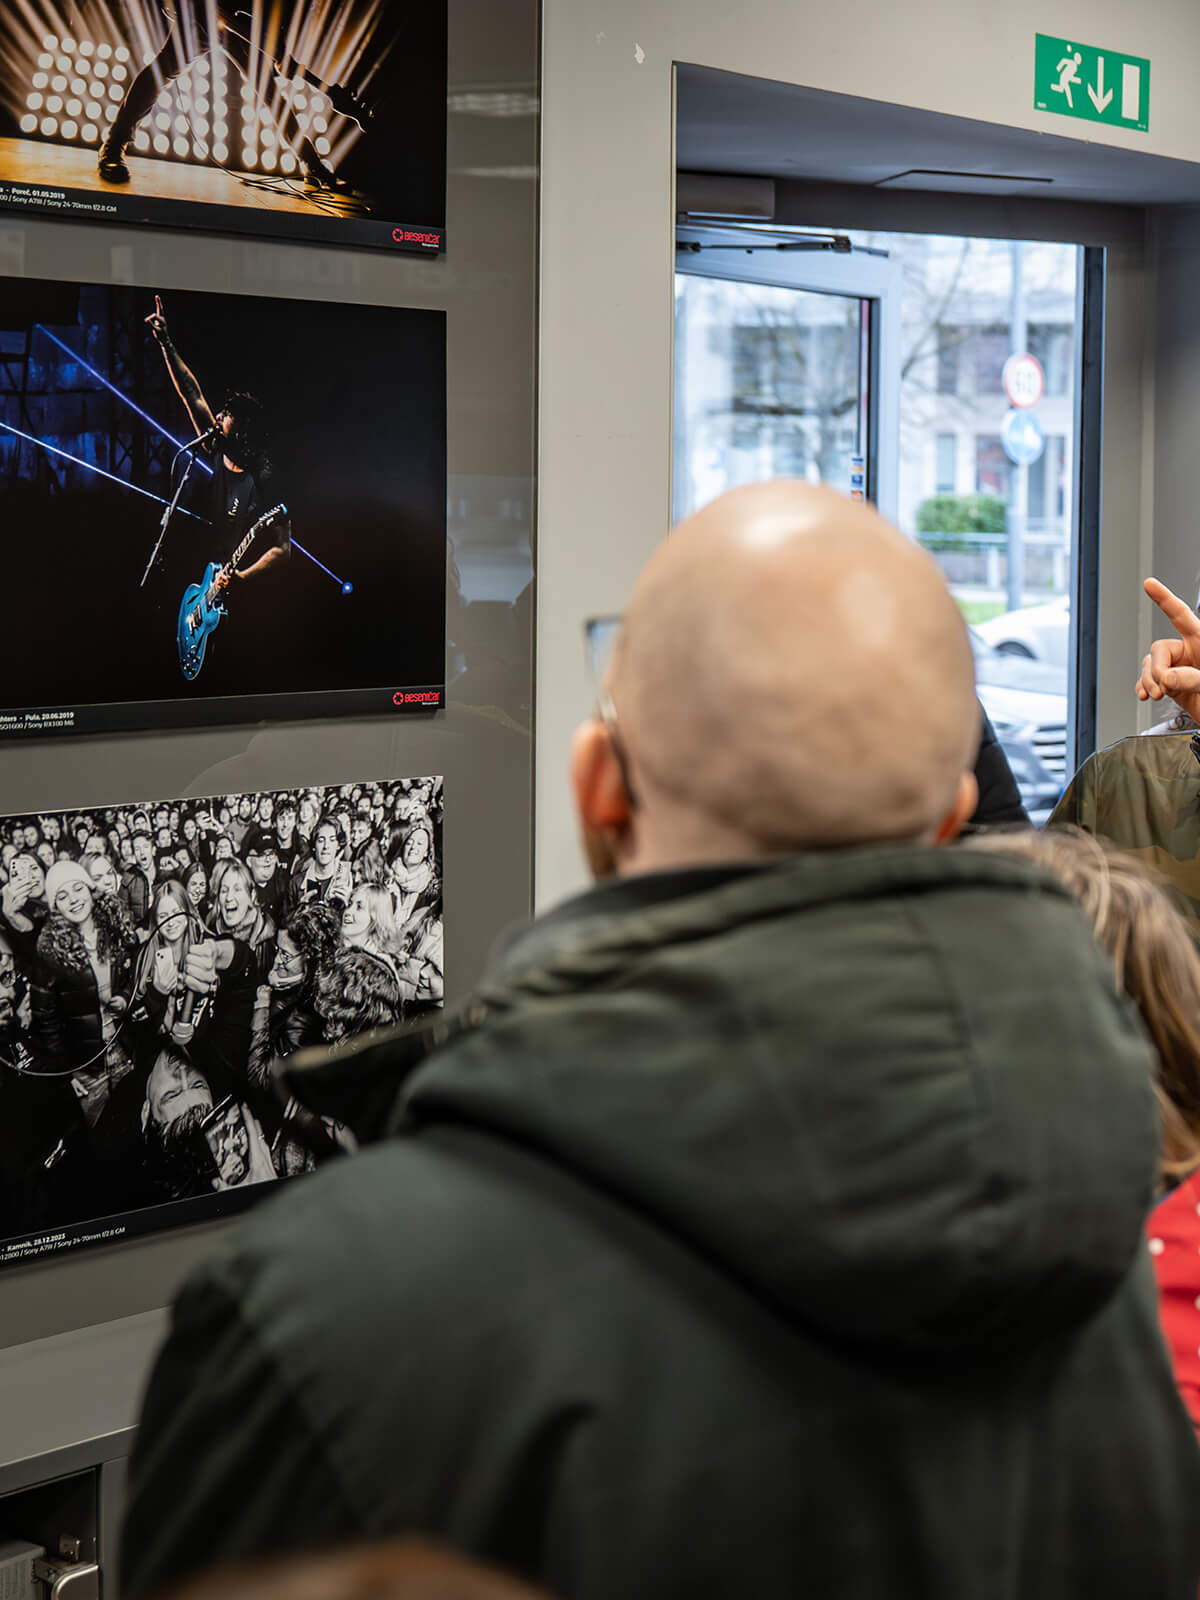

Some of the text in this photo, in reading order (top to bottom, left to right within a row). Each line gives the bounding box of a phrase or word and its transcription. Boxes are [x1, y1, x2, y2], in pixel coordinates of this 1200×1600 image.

[12, 196, 28, 205] Sony
[47, 200, 62, 208] Sony
[28, 721, 42, 729] Sony
[24, 1246, 39, 1256] Sony
[57, 1239, 72, 1249] Sony
